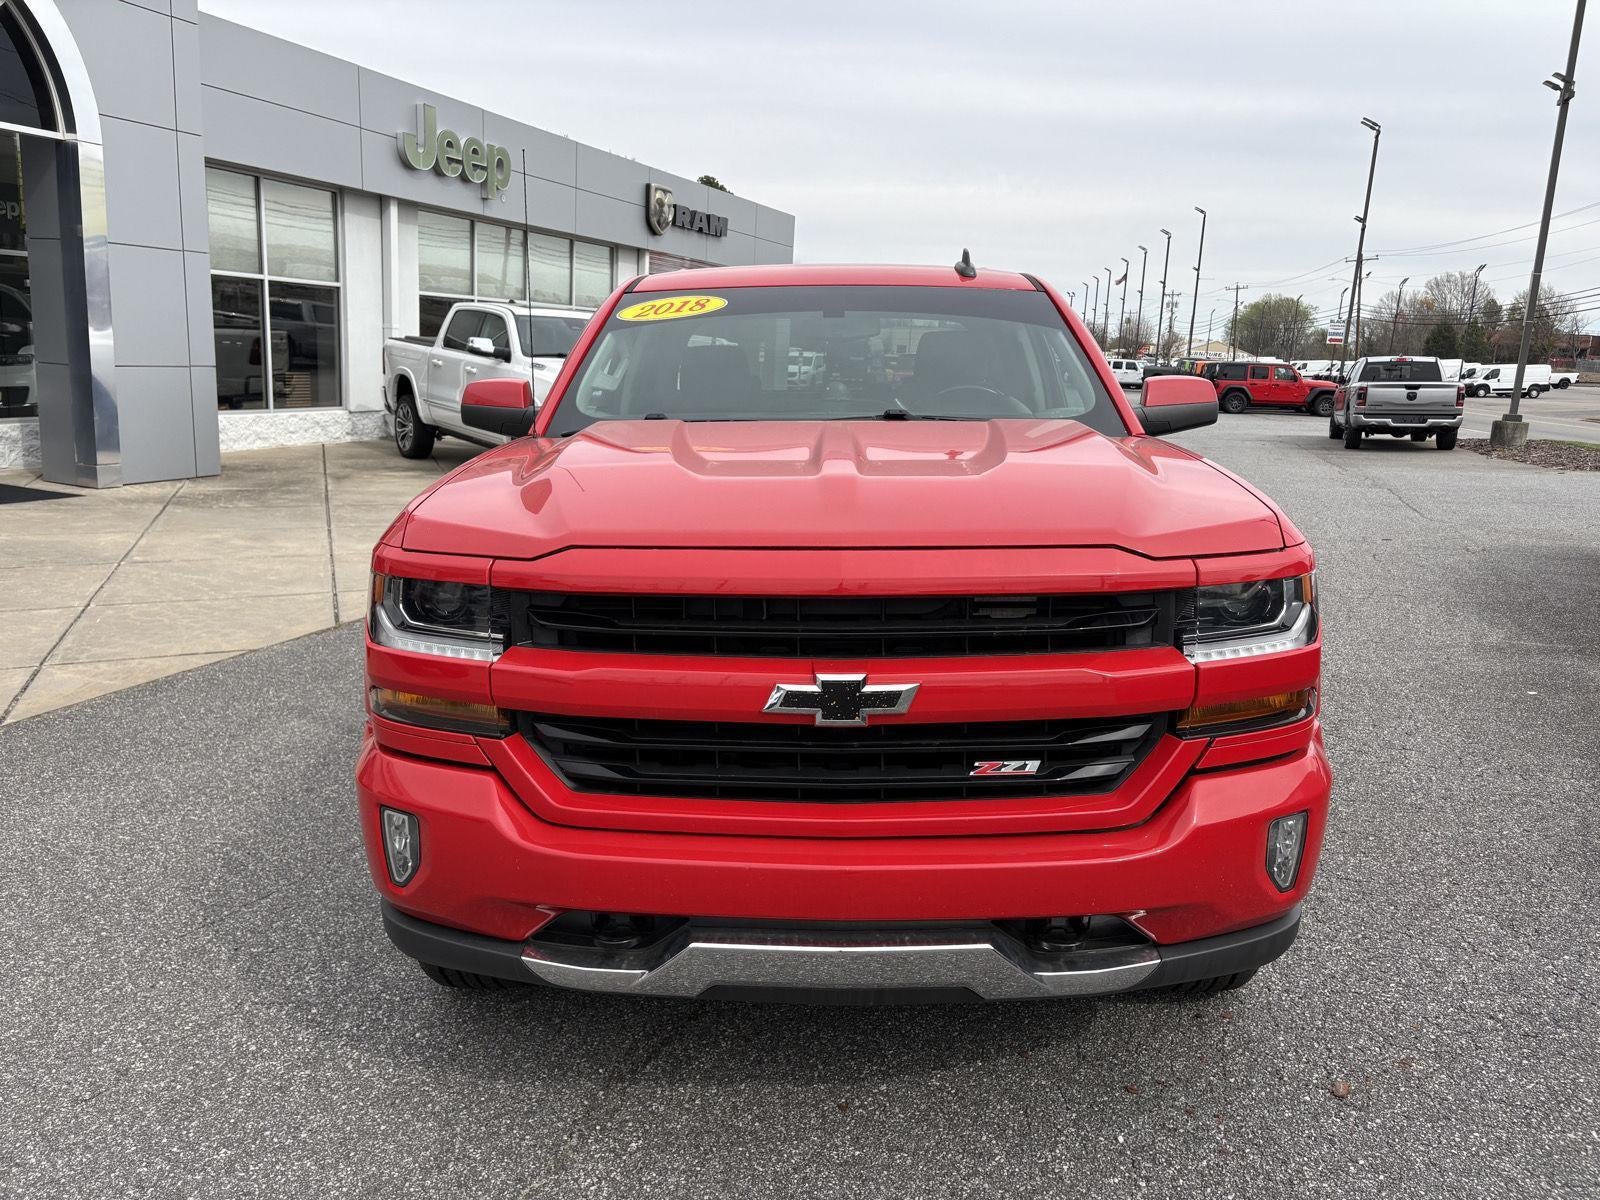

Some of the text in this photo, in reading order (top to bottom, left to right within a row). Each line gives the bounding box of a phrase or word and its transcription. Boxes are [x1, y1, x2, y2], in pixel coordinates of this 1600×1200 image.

[397, 103, 511, 200] Jeep
[674, 204, 728, 237] RAM
[633, 298, 710, 318] 2018
[969, 760, 1041, 776] Z71
